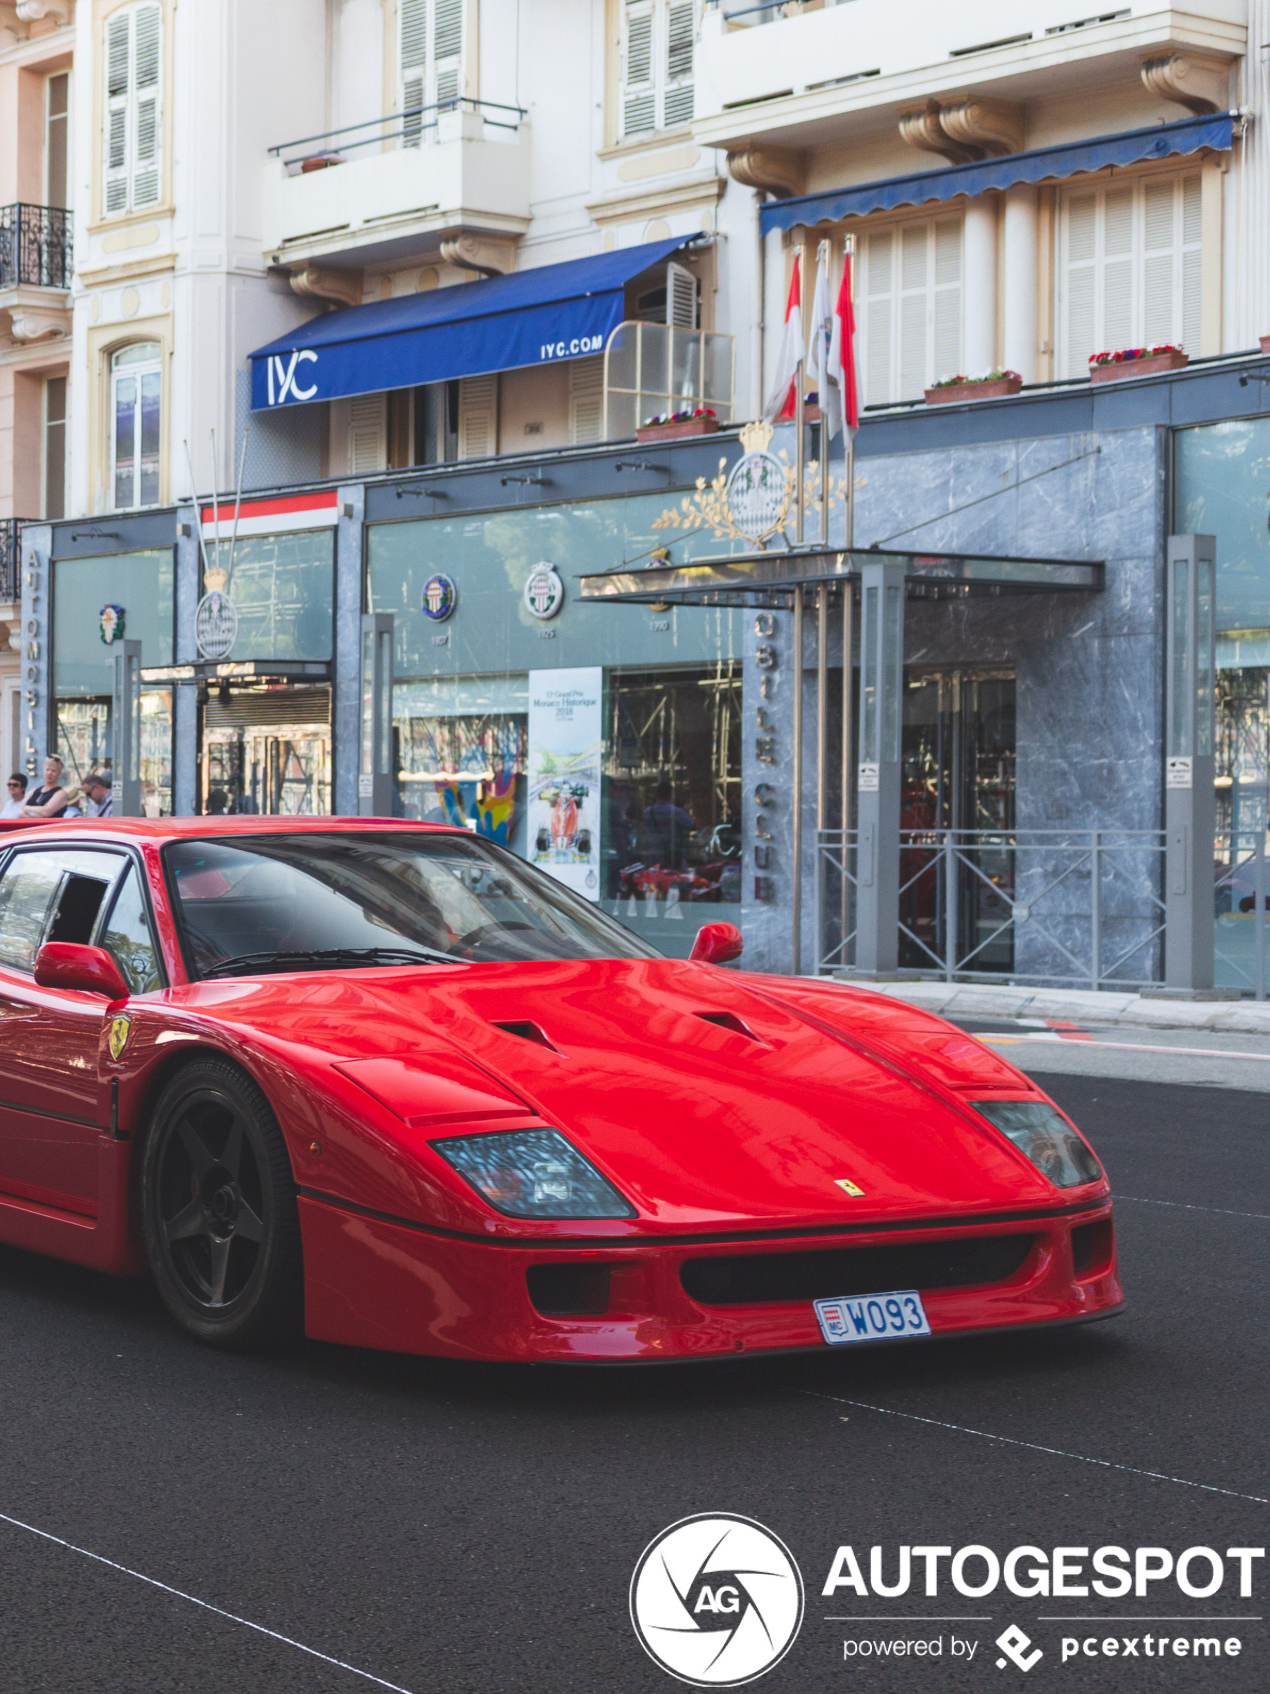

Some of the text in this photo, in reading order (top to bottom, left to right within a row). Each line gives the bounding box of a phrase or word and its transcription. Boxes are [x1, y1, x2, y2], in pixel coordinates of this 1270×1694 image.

[541, 335, 603, 359] IYC.COM
[267, 348, 318, 405] IYC
[26, 549, 41, 777] AUTOMOBILE
[533, 698, 596, 708] Monaco Historique
[555, 708, 573, 716] 2018
[754, 783, 774, 900] CLUB
[829, 1297, 923, 1335] MC W093
